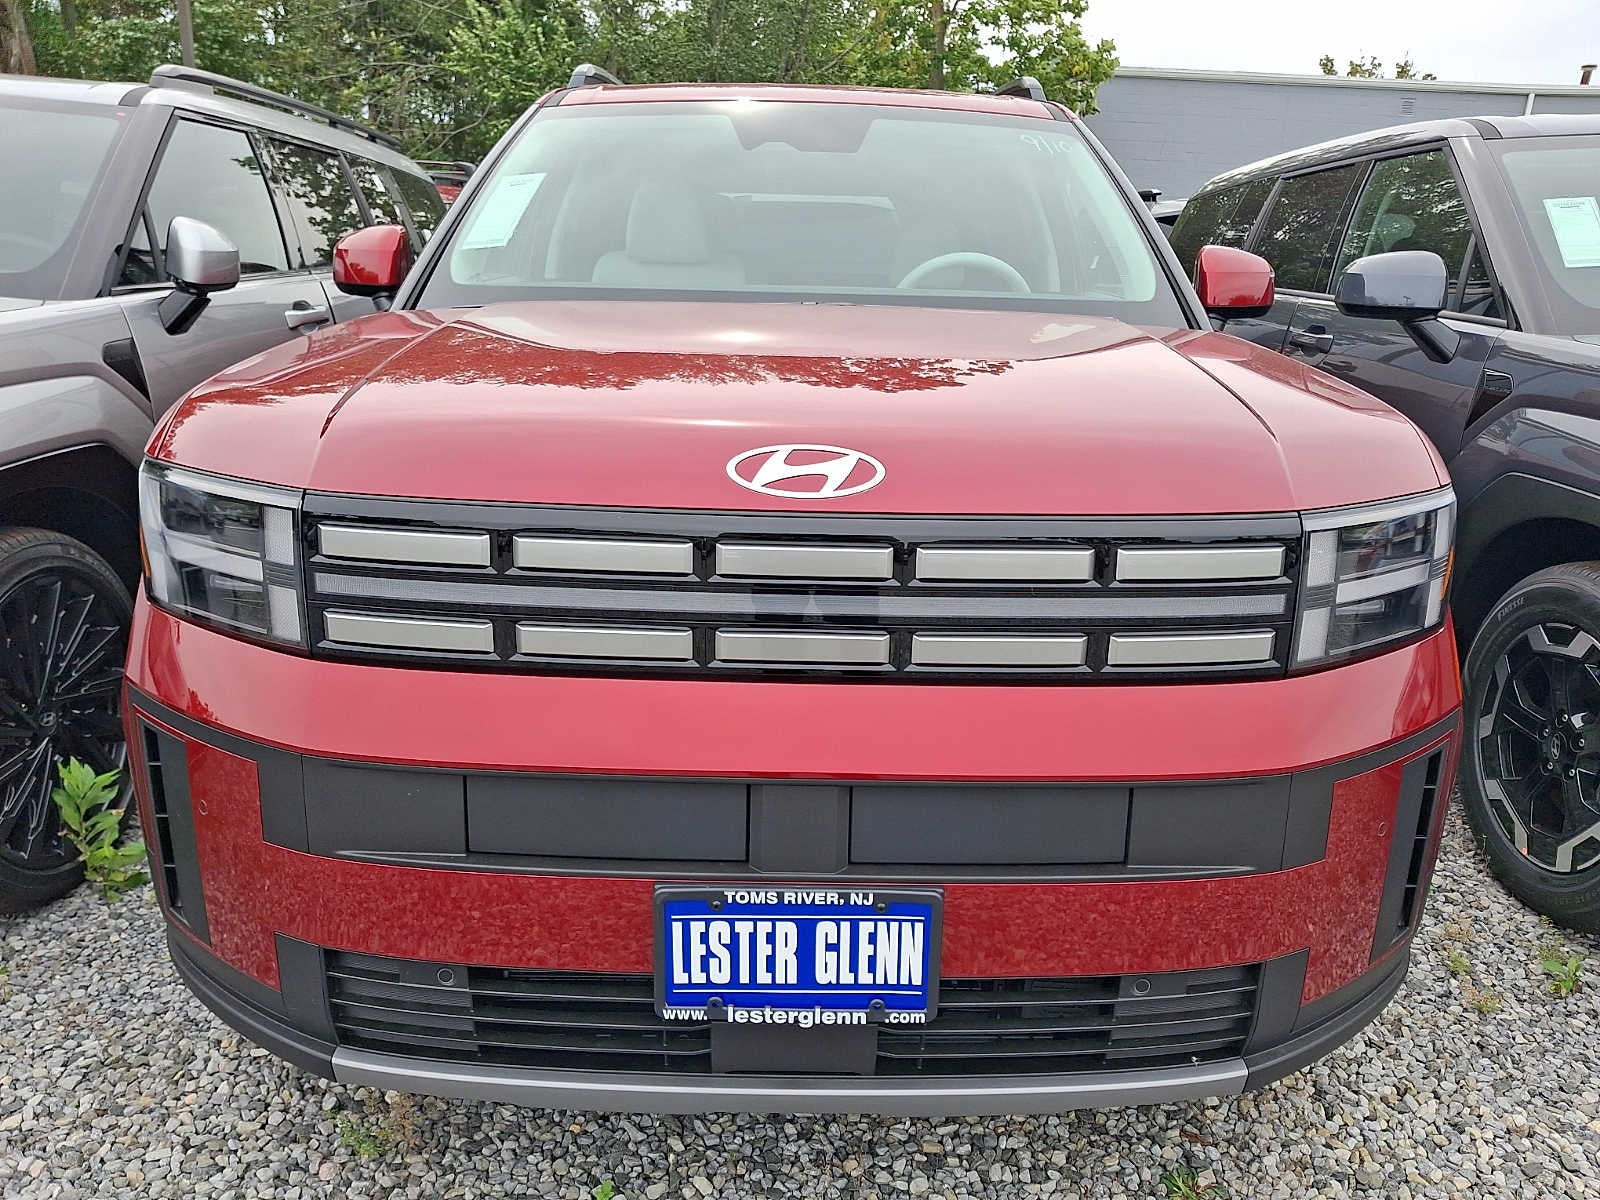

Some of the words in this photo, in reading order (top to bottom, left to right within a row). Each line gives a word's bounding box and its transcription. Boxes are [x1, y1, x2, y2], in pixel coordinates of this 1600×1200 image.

[724, 889, 778, 905] TOMS
[783, 891, 845, 906] RIVER,
[850, 892, 874, 906] NJ
[672, 920, 798, 985] LESTER
[815, 920, 924, 986] GLENN
[662, 1008, 708, 1021] www.
[727, 1006, 867, 1027] lesterglenn
[884, 1011, 926, 1025] .com
